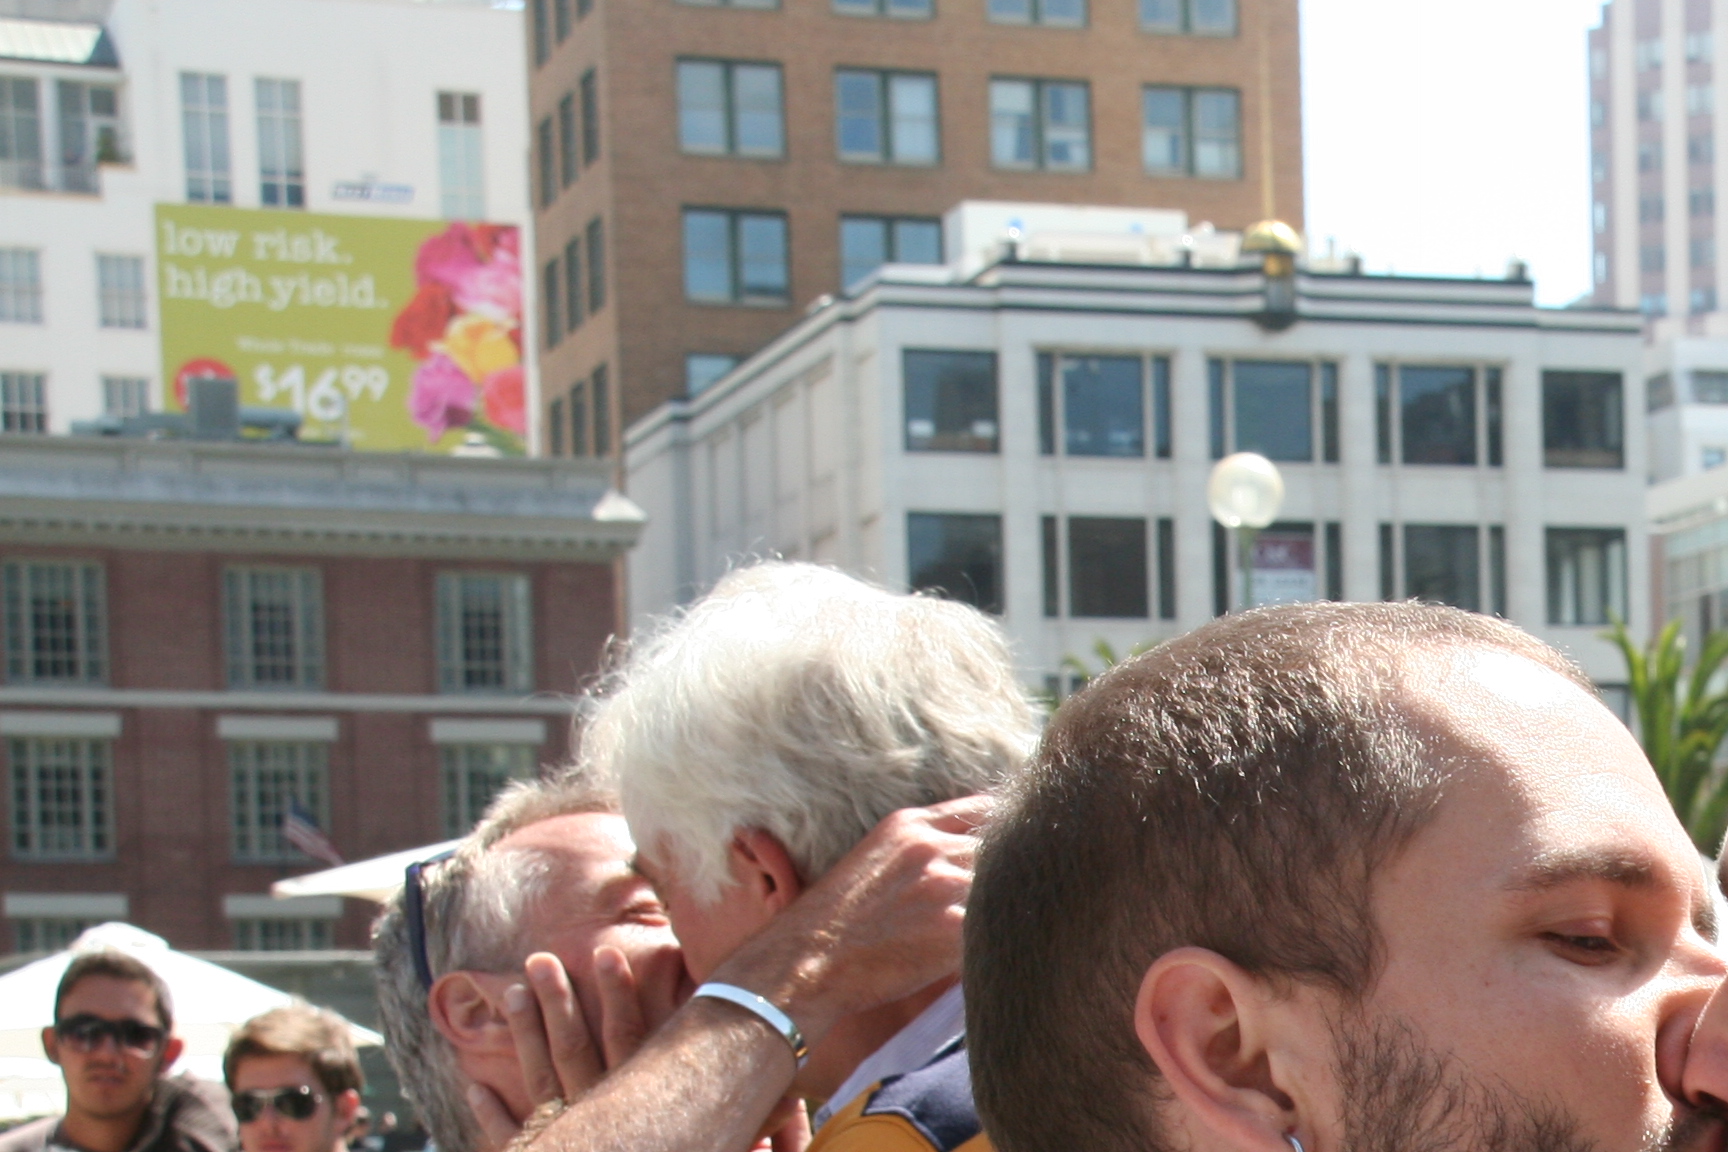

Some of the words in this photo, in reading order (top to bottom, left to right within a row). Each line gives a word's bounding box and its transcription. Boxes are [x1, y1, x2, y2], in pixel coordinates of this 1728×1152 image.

[163, 219, 240, 258] low
[252, 227, 353, 264] risk.
[164, 262, 264, 309] high
[266, 269, 389, 311] yield.
